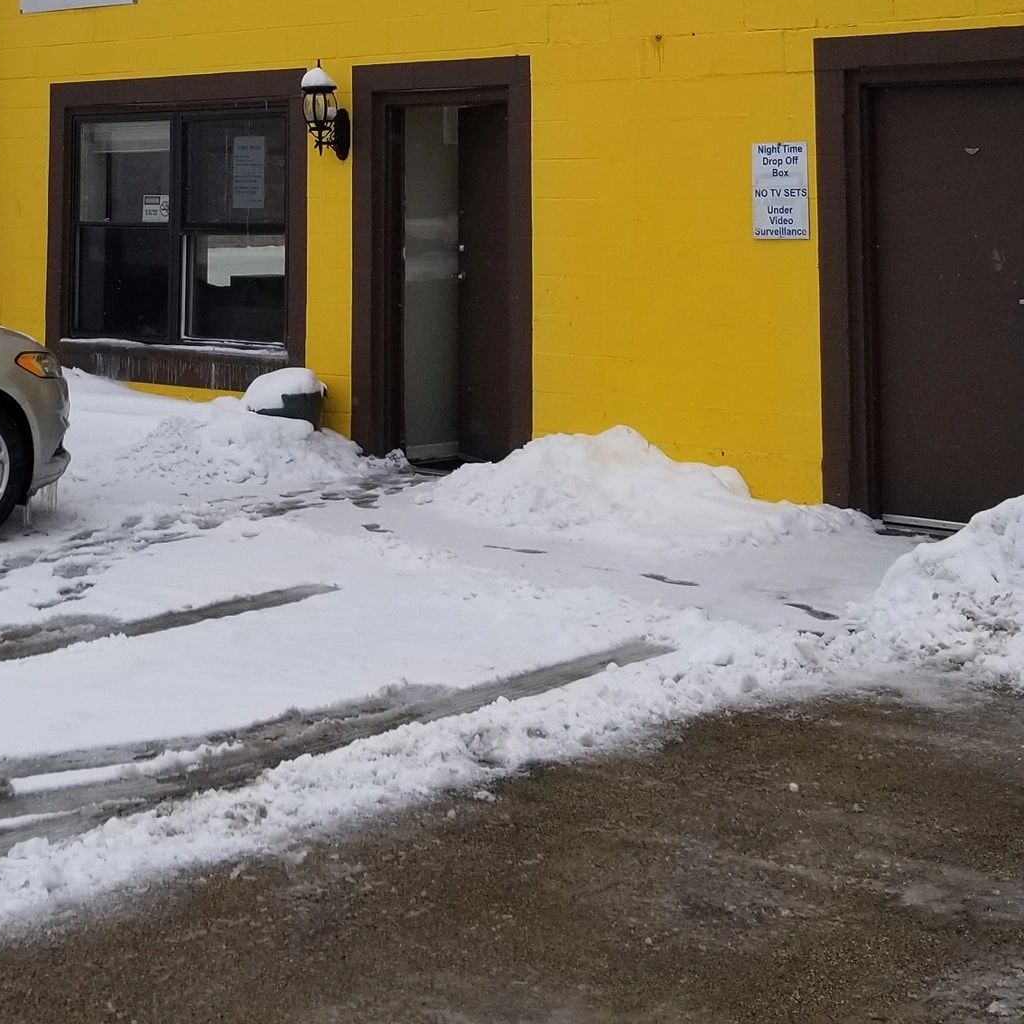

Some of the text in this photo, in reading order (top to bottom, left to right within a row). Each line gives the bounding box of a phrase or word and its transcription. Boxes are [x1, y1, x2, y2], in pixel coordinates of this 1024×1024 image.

[758, 145, 803, 155] Night Time
[762, 156, 798, 167] Drop Off
[772, 169, 789, 177] Box
[754, 188, 807, 197] NO TV SETS
[767, 206, 793, 214] Under
[769, 216, 794, 225] Video
[754, 227, 807, 236] Surveillance
